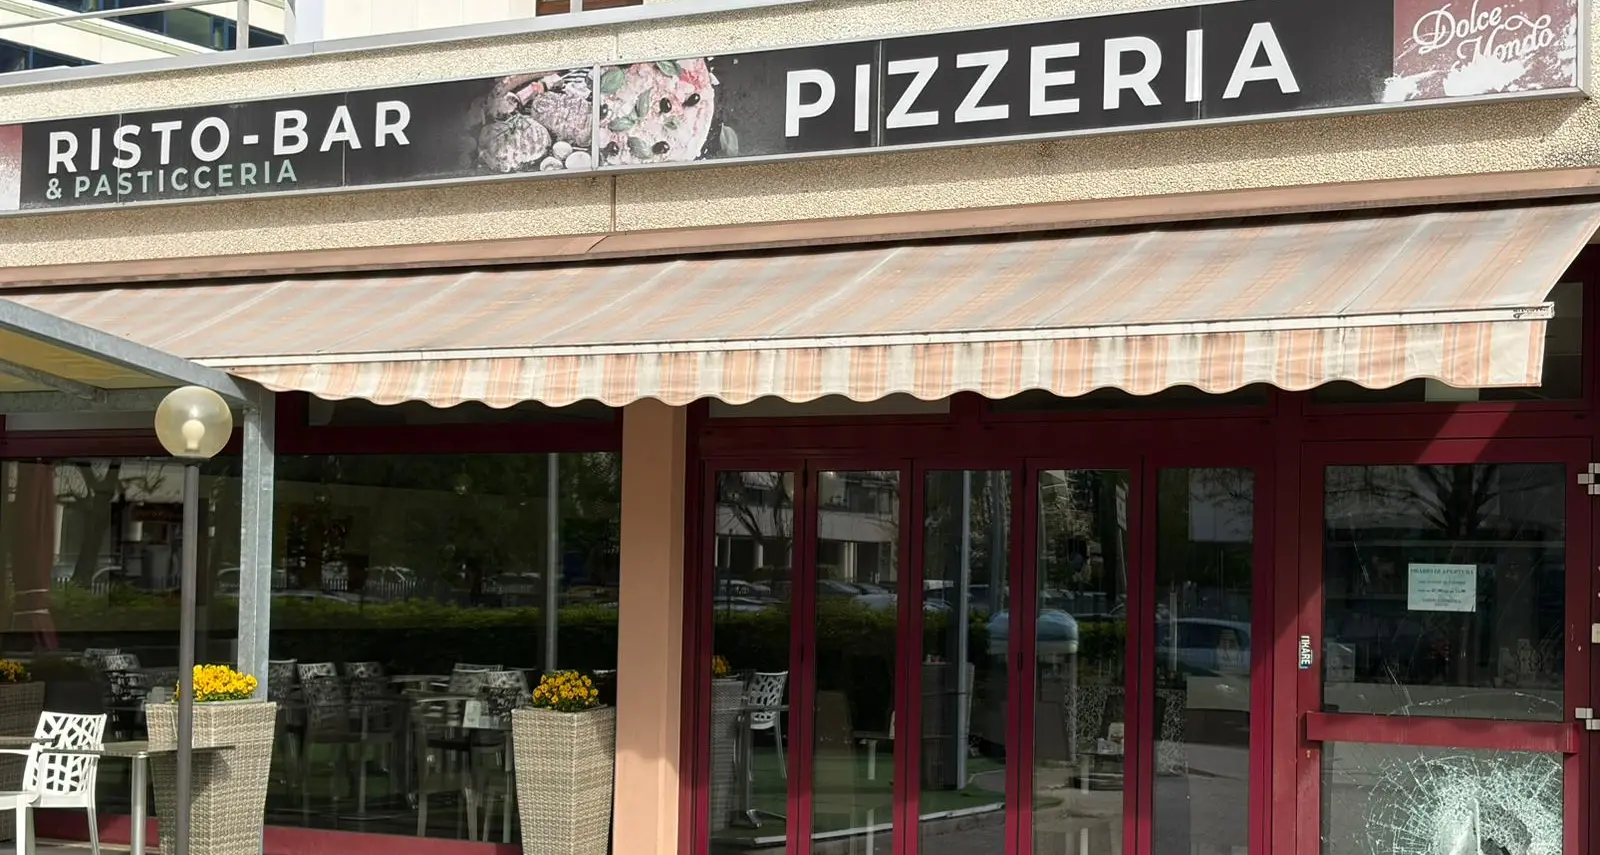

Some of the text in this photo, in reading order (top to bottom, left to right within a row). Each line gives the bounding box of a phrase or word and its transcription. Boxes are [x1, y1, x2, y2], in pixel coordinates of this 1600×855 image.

[1405, 0, 1502, 54] Dolce
[785, 22, 1300, 137] PIZZERIA
[48, 100, 411, 174] RISTO-BAR
[46, 159, 297, 200] & PASTICCERIA
